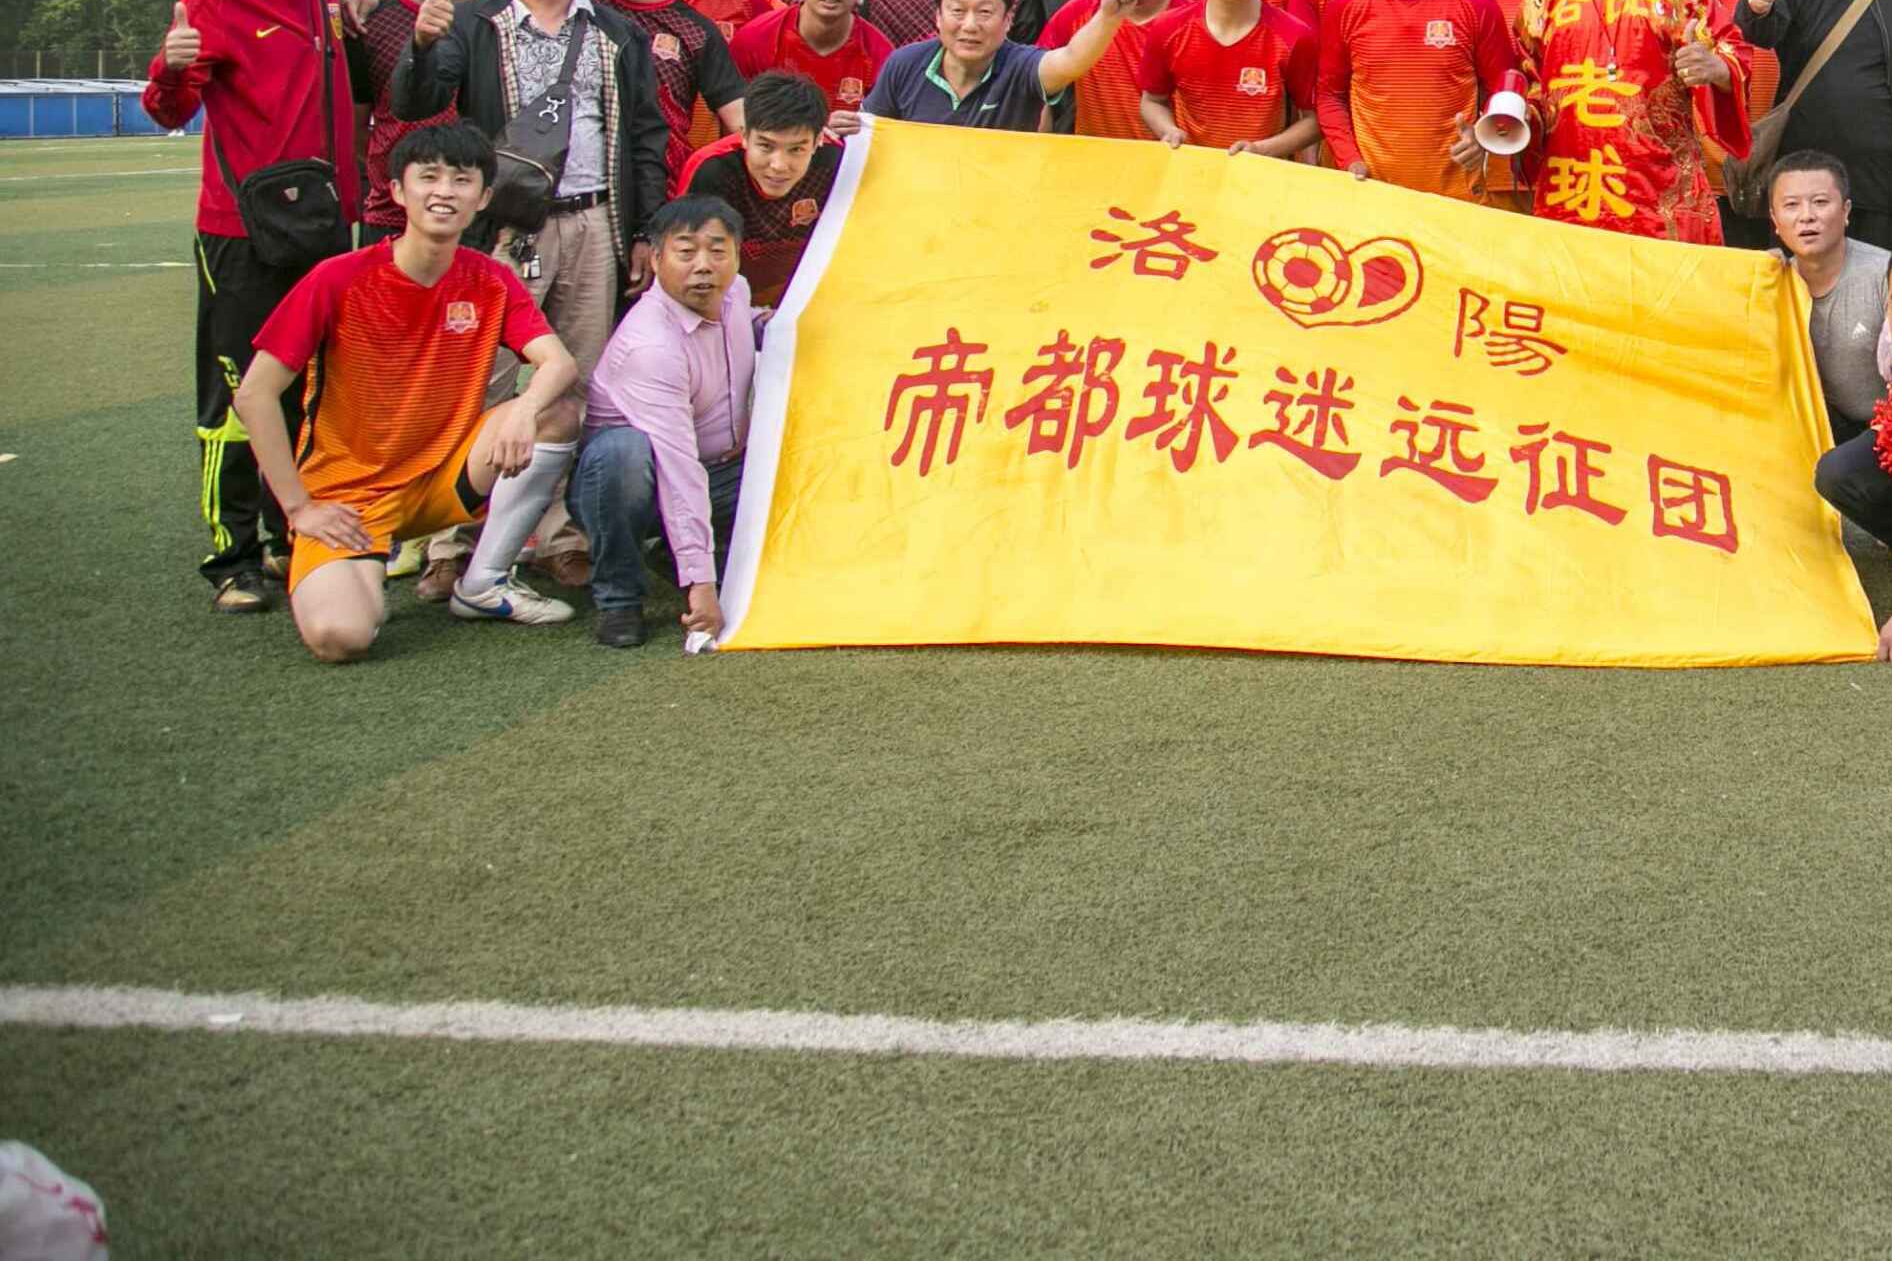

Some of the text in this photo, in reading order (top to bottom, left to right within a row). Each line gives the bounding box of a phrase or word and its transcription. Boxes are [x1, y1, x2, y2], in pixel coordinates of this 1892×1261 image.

[1090, 206, 1568, 376] 洛 陽
[884, 327, 1739, 554] 帝都球迷远征团
